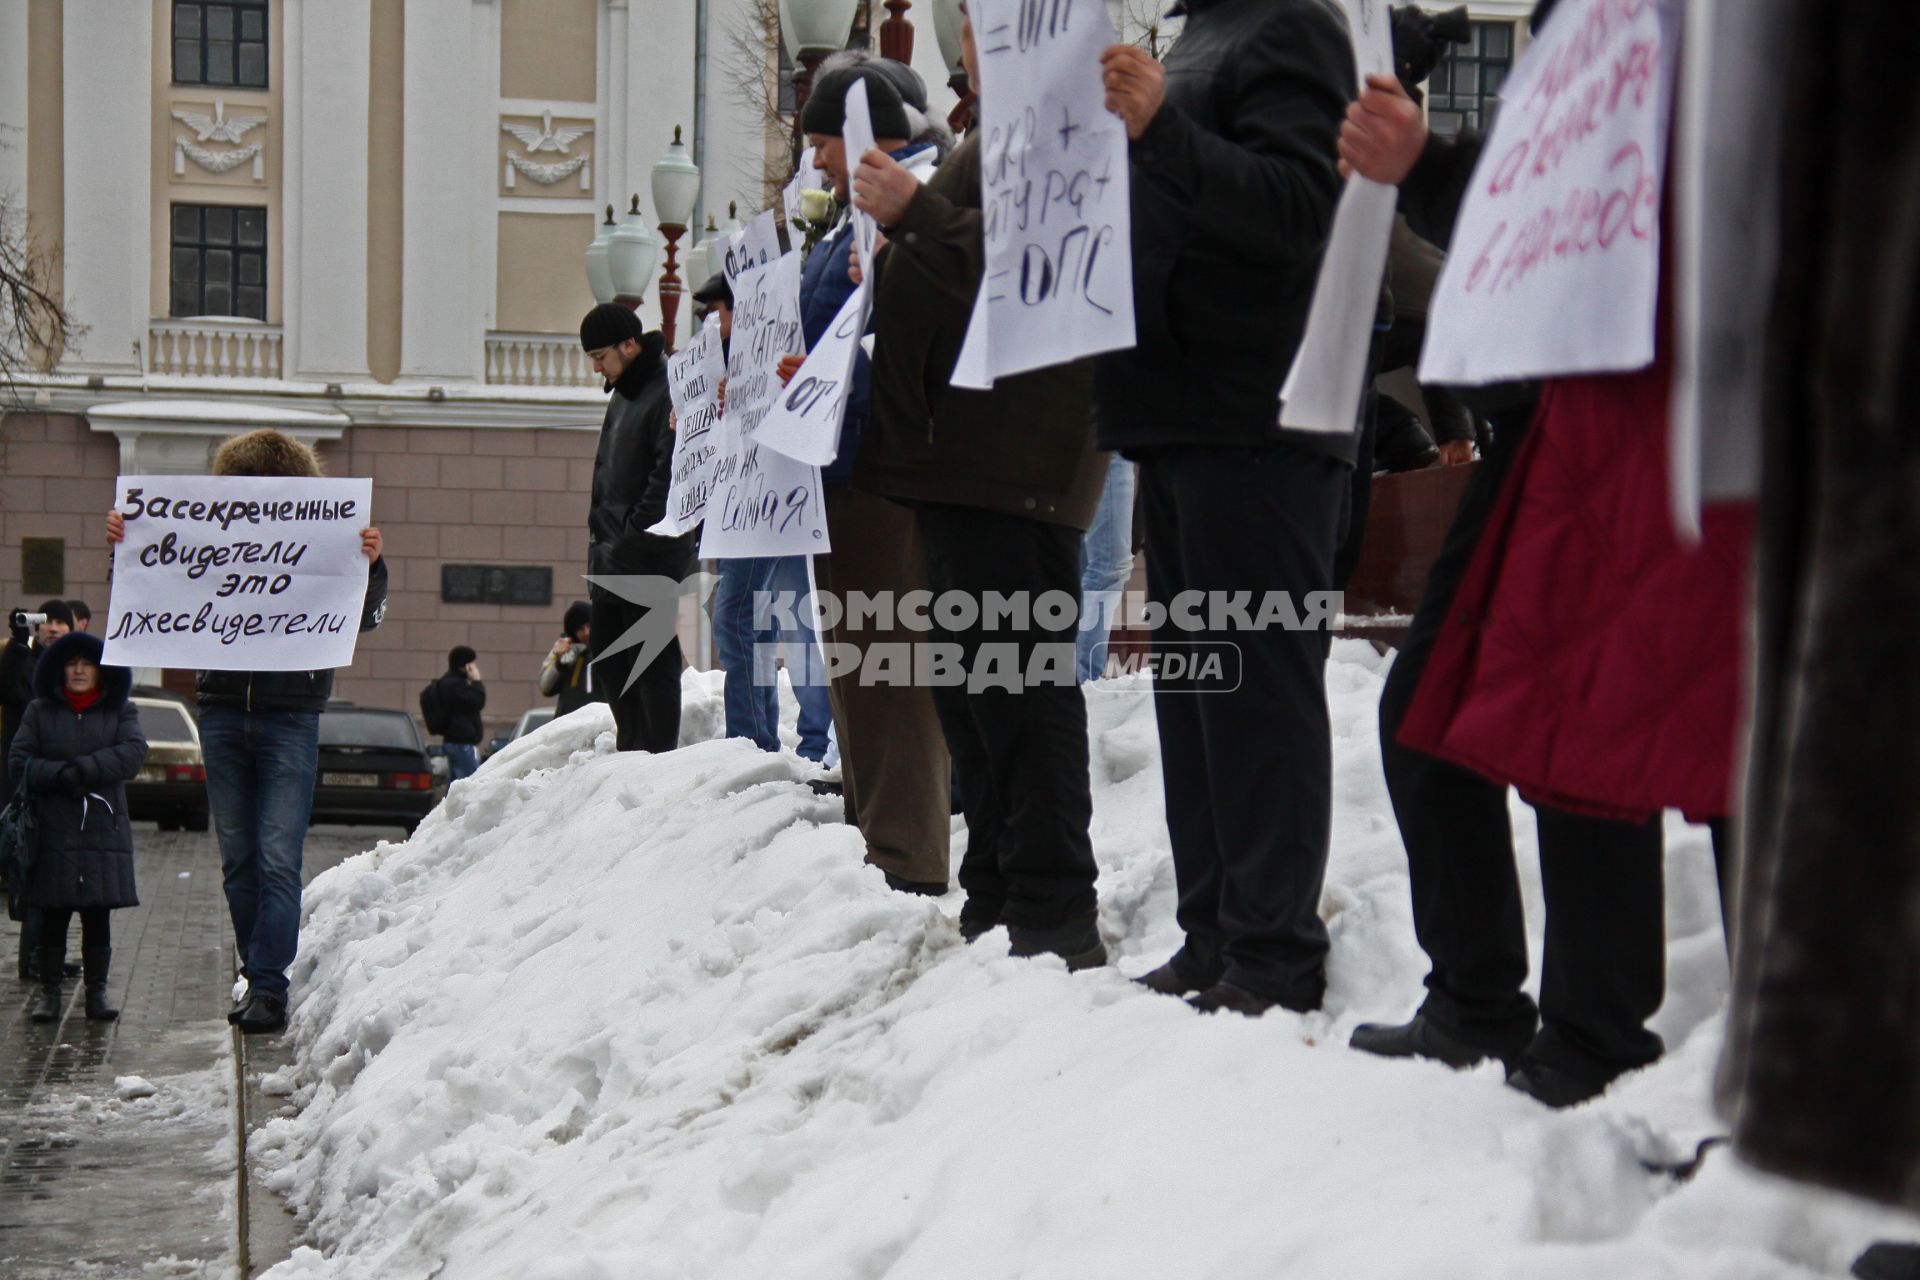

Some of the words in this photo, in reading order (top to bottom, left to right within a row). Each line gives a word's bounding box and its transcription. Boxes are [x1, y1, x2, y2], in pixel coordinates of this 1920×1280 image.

[121, 488, 356, 531] Засекреченные
[140, 532, 307, 579] свидетели
[216, 573, 292, 598] это
[108, 602, 347, 645] лжесвидетели
